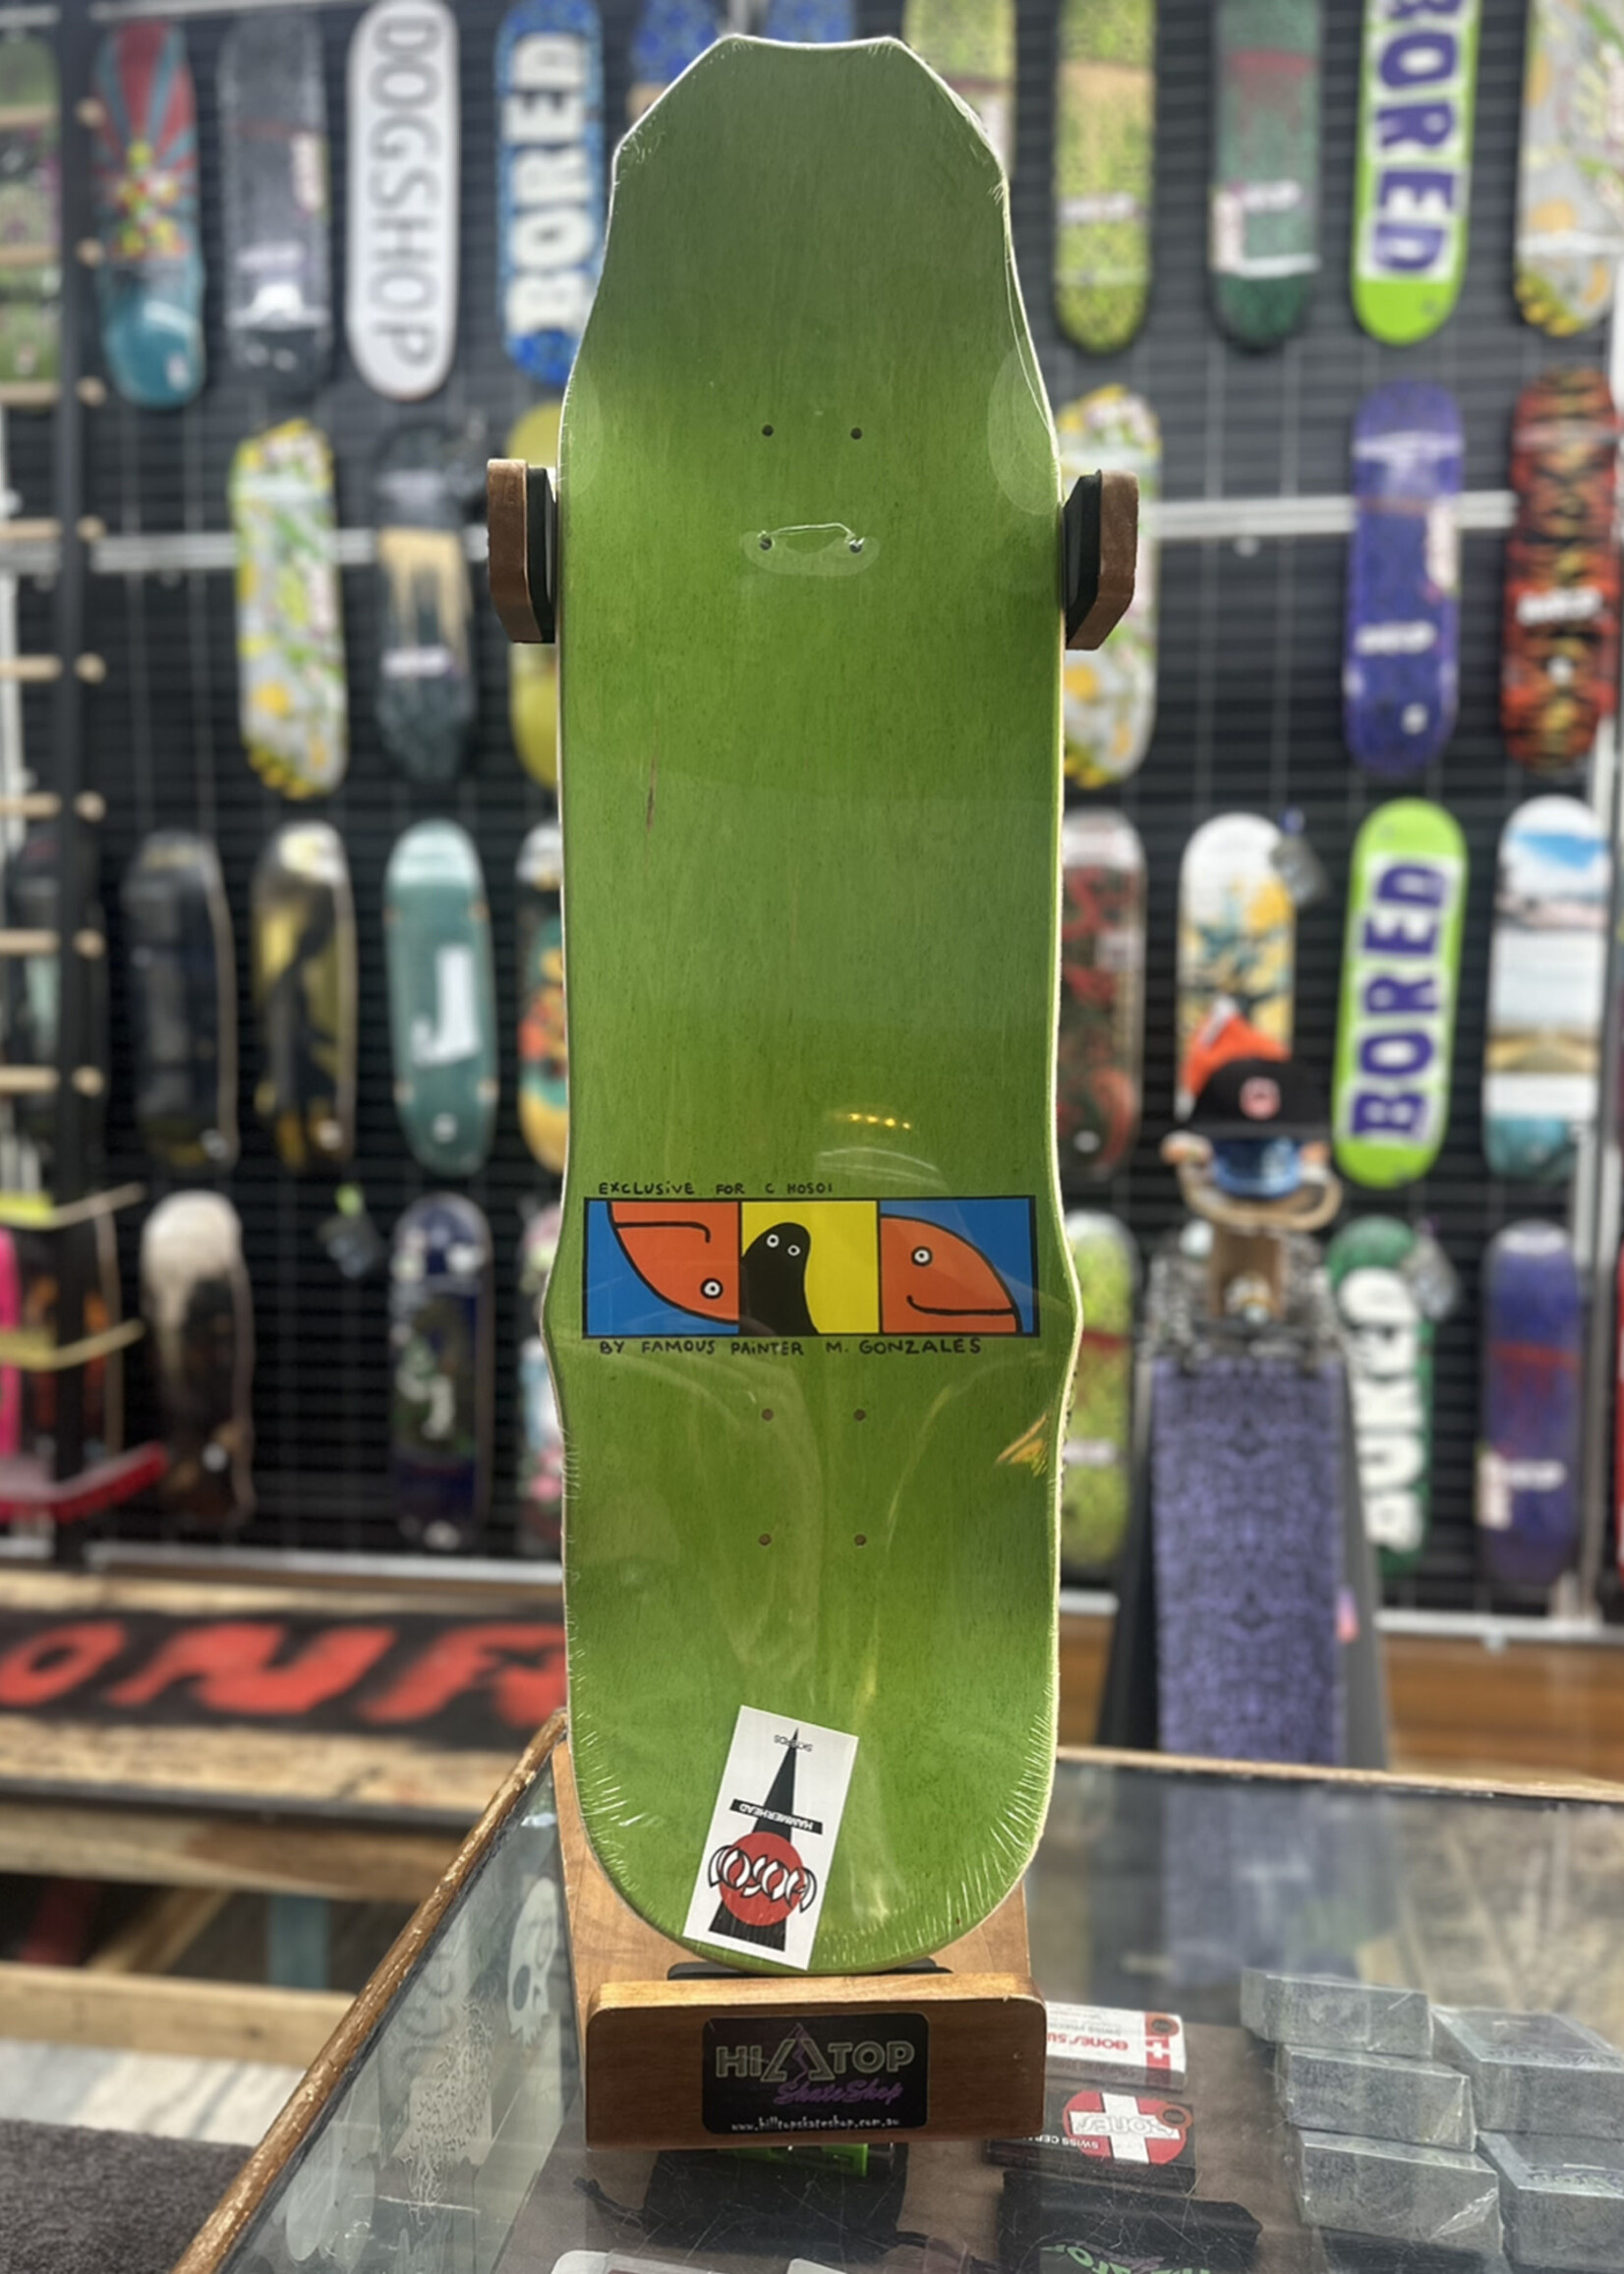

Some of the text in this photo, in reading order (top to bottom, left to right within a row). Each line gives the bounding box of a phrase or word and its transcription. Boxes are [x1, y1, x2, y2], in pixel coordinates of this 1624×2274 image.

[368, 16, 441, 369] DOGSHOP
[1350, 863, 1450, 1140] BORED
[716, 1182, 746, 1195] FOR
[765, 1182, 775, 1194] C
[787, 1182, 834, 1194] HOSOI
[600, 1340, 625, 1355] BY
[641, 1340, 717, 1355] FAMOUS
[826, 1341, 849, 1355] M.
[859, 1337, 983, 1355] GONZALES
[738, 1802, 815, 1832] HAMMERHEAD
[1070, 2033, 1130, 2052] BONES
[1062, 2136, 1100, 2150] SWISS
